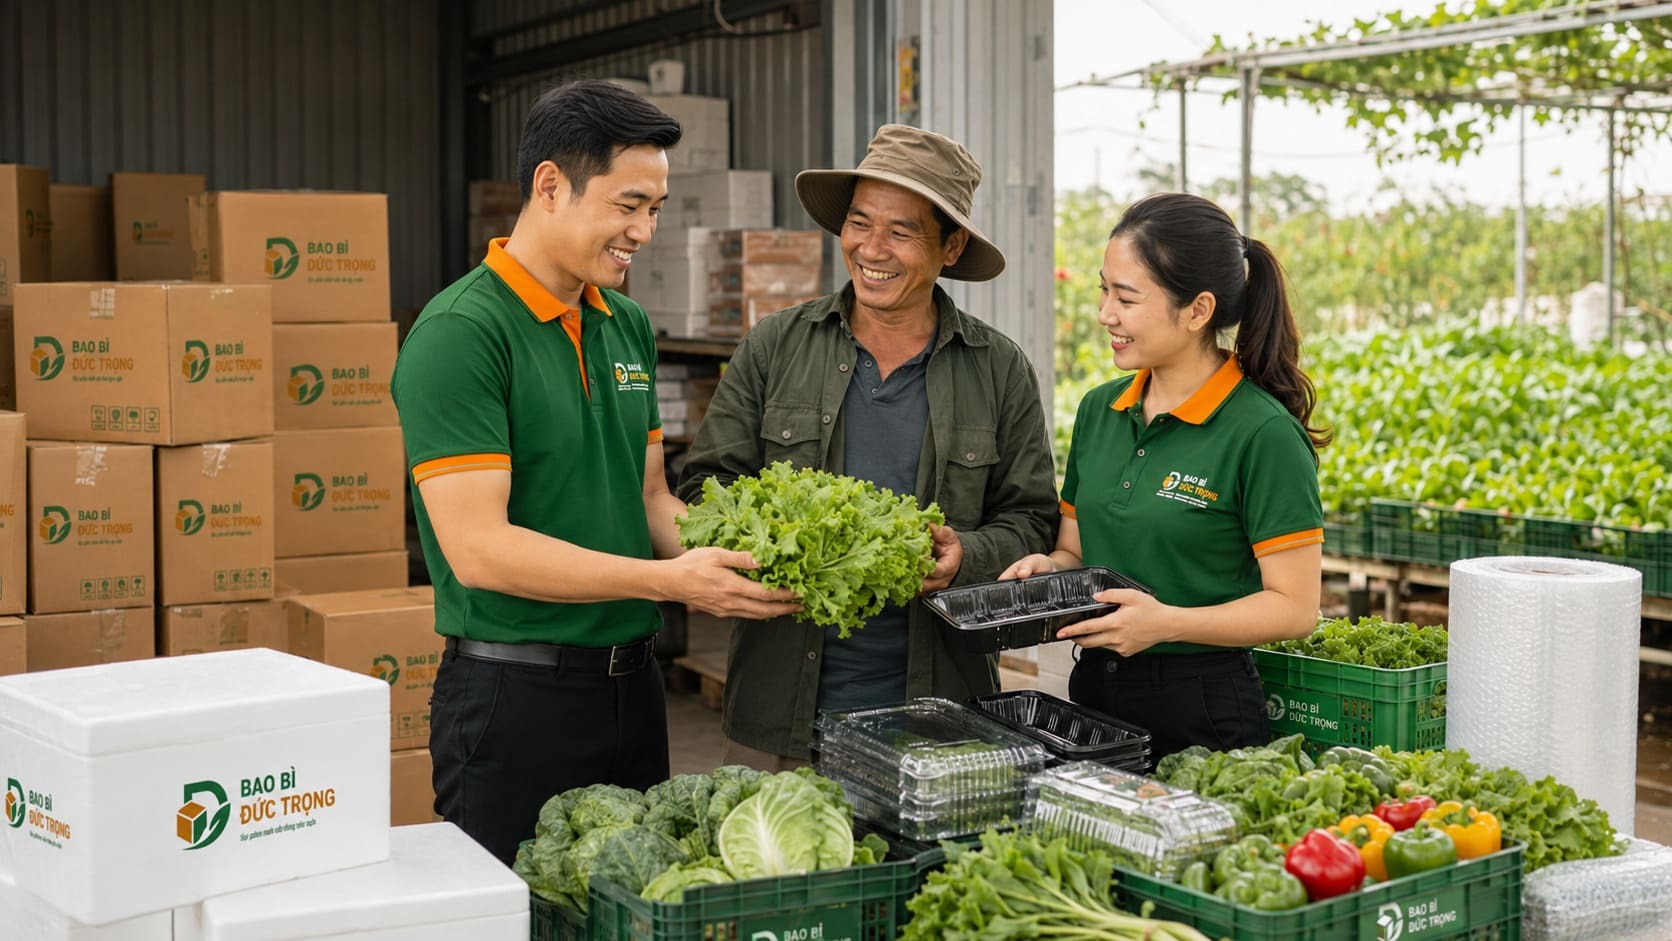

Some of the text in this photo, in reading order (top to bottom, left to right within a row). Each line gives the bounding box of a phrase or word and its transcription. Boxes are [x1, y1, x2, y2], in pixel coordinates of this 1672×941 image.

[307, 242, 333, 255] BAO
[72, 340, 96, 353] BAO
[215, 344, 234, 356] BAO
[332, 367, 356, 380] BAO
[331, 475, 355, 488] BAO
[78, 509, 99, 521] BAO
[211, 503, 231, 515] BAO
[406, 655, 426, 666] BAO
[1289, 699, 1308, 712] BAO
[1309, 716, 1339, 730] TRỌNG
[240, 765, 296, 798] BAO BÌ
[29, 789, 53, 812] BAO BÌ
[240, 788, 336, 825] ĐỨC TRỌNG
[45, 815, 71, 840] TRỌNG
[1408, 903, 1427, 918] BAO
[783, 928, 808, 941] BAO
